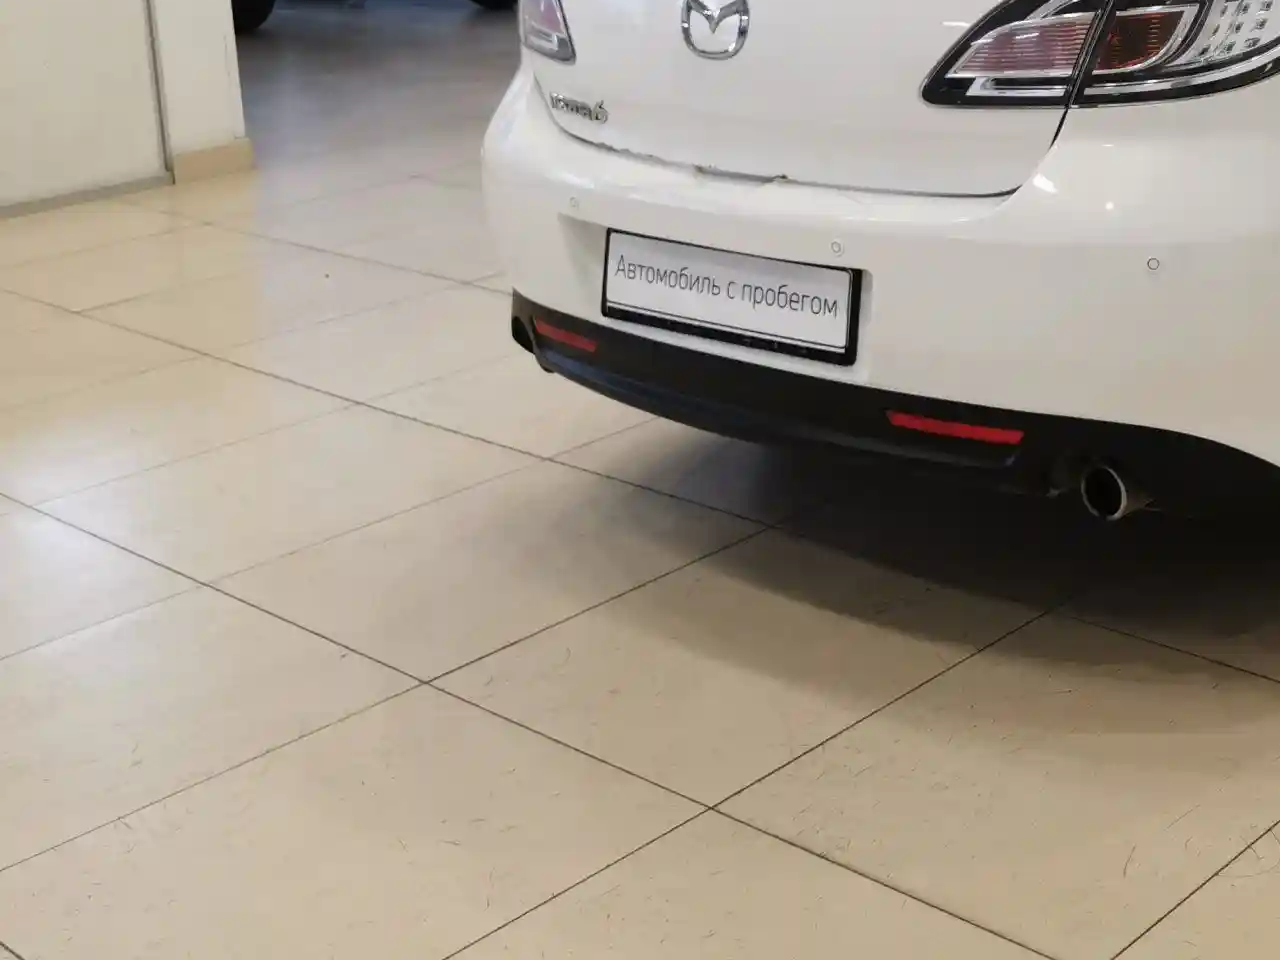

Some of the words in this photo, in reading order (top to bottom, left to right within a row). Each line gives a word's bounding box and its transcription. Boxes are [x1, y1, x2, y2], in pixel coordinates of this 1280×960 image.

[614, 254, 721, 296] Автомобиль
[727, 281, 738, 300] с
[741, 284, 838, 319] пробегом
